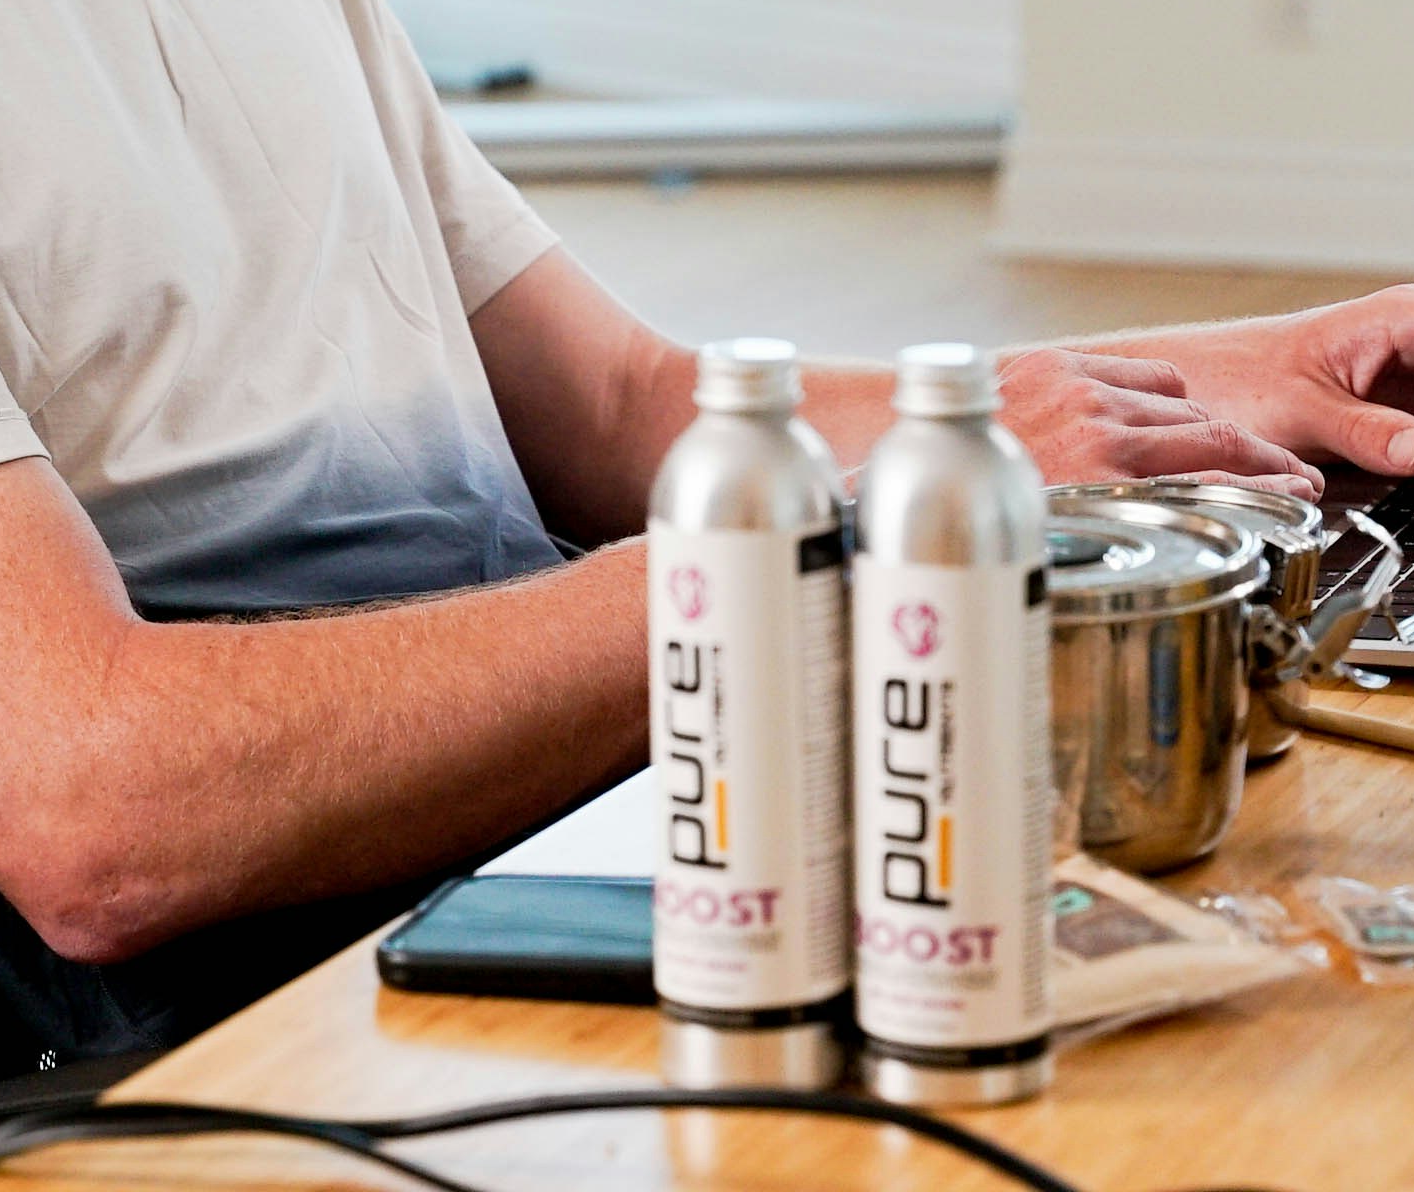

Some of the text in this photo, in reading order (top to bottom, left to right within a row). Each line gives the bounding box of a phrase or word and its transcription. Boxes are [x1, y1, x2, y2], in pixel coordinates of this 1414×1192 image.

[666, 641, 729, 871] pure
[883, 678, 951, 909] pure
[654, 883, 782, 927] OOST
